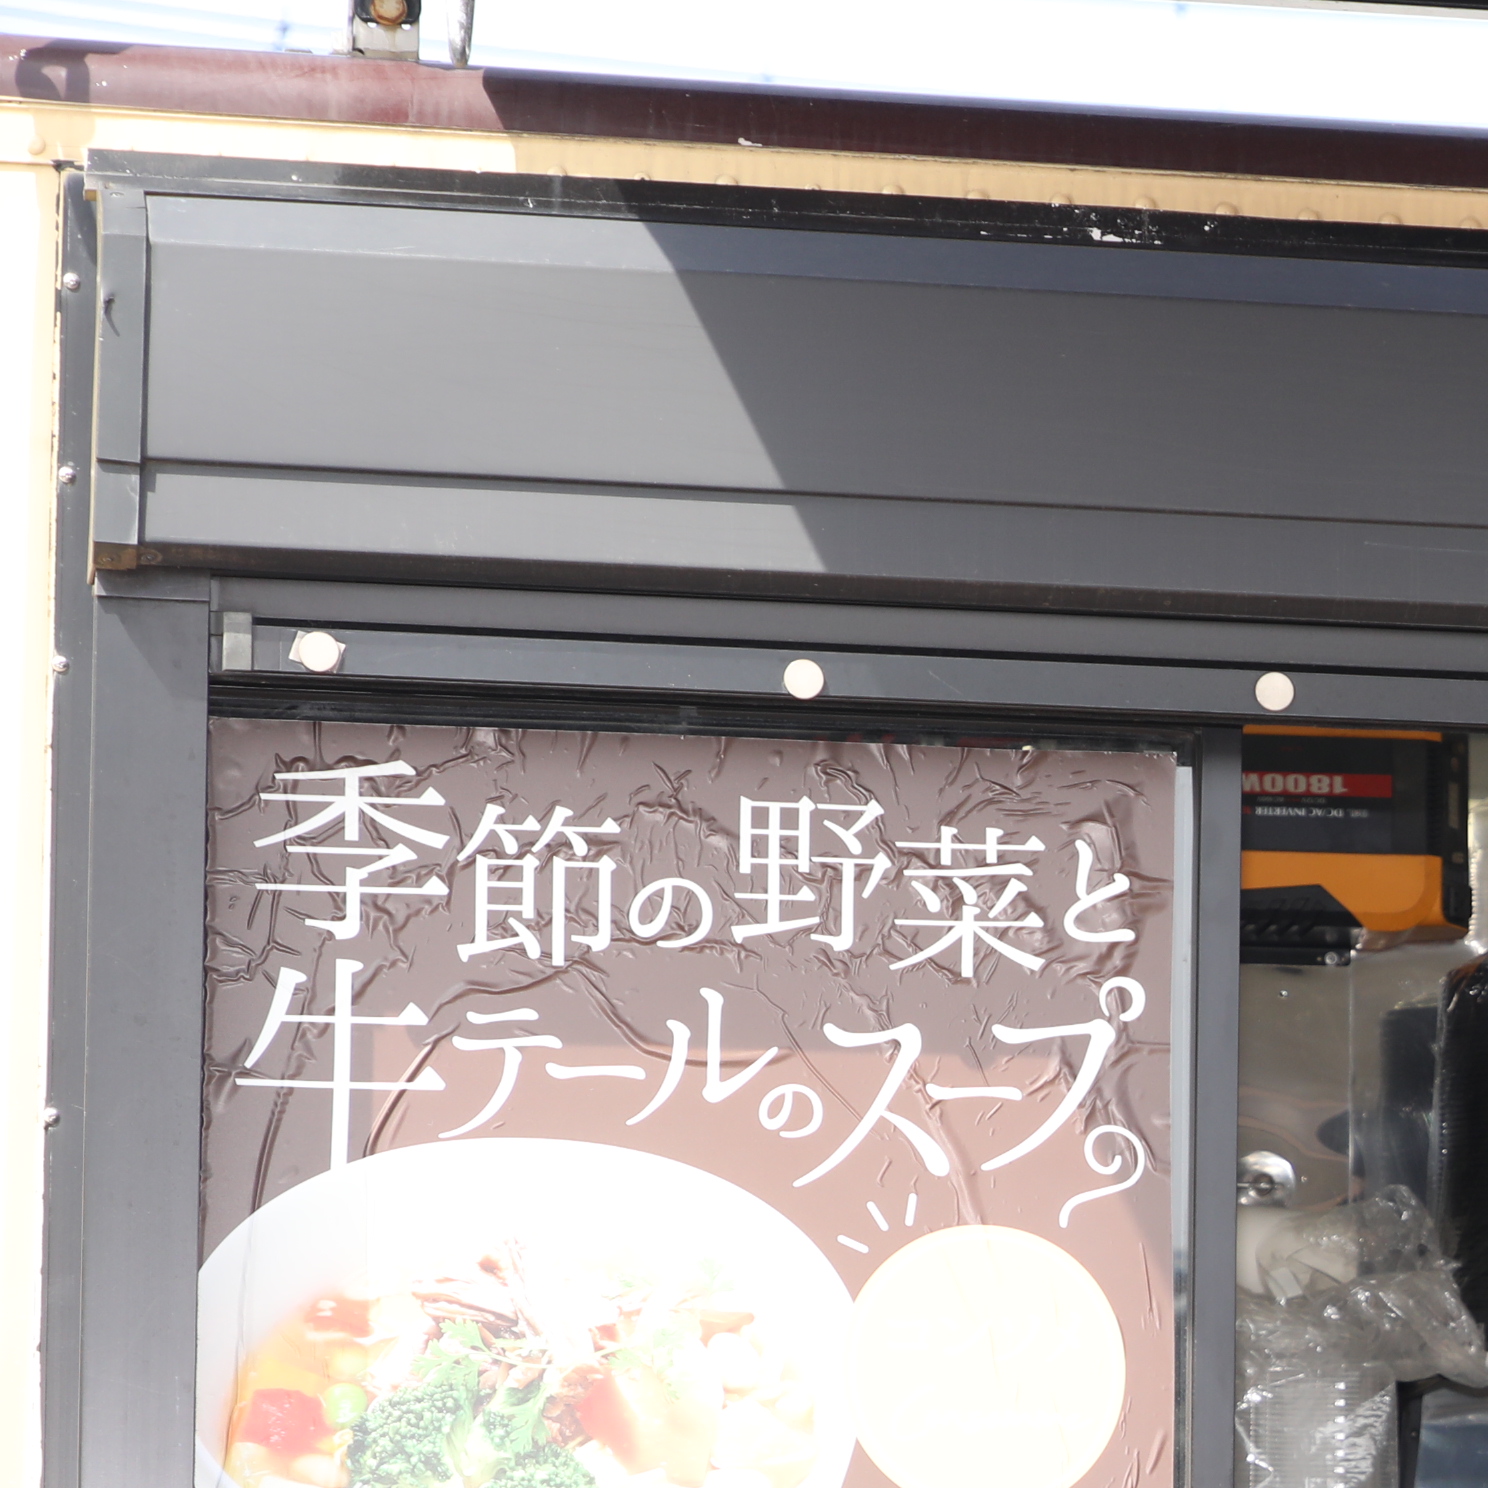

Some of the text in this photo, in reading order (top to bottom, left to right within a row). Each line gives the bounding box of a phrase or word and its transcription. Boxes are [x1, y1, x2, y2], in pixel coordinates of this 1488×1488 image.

[1254, 805, 1306, 817] INVERTER
[254, 760, 1135, 978] 季節の野菜と
